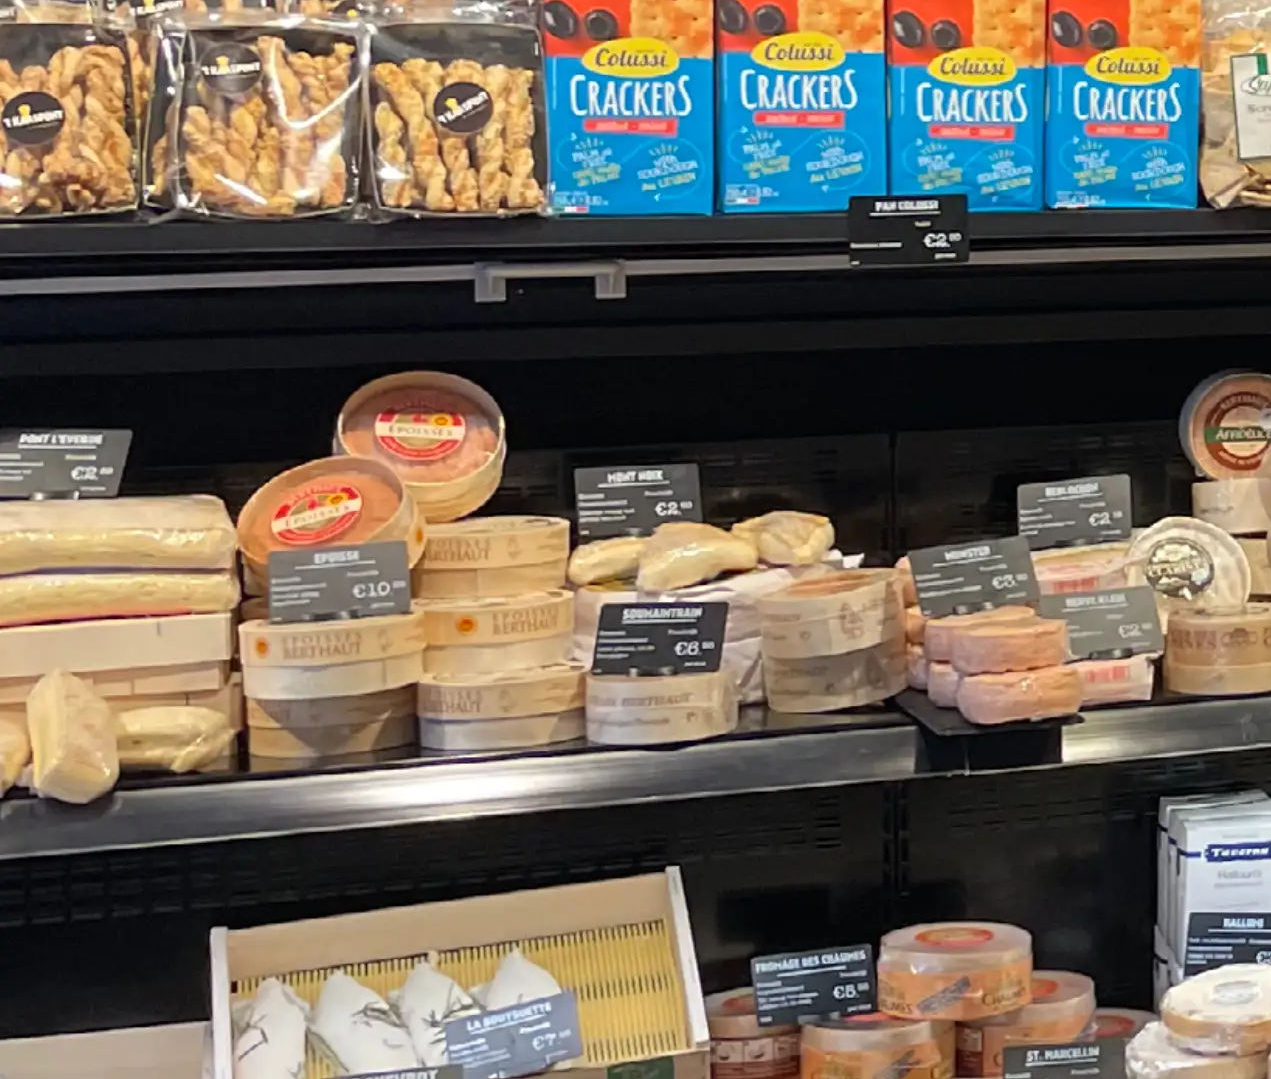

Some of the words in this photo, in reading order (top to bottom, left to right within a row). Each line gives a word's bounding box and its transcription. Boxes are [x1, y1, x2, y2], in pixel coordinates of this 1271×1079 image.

[593, 46, 667, 68] Colussi
[763, 42, 834, 63] Colussi
[938, 56, 1006, 76] Colussi
[1095, 55, 1160, 75] Colussi
[569, 74, 692, 117] CRACKERS
[739, 69, 858, 110] CRACKERS
[915, 81, 1029, 123] CRACKERS
[1072, 80, 1182, 122] CRACKERS
